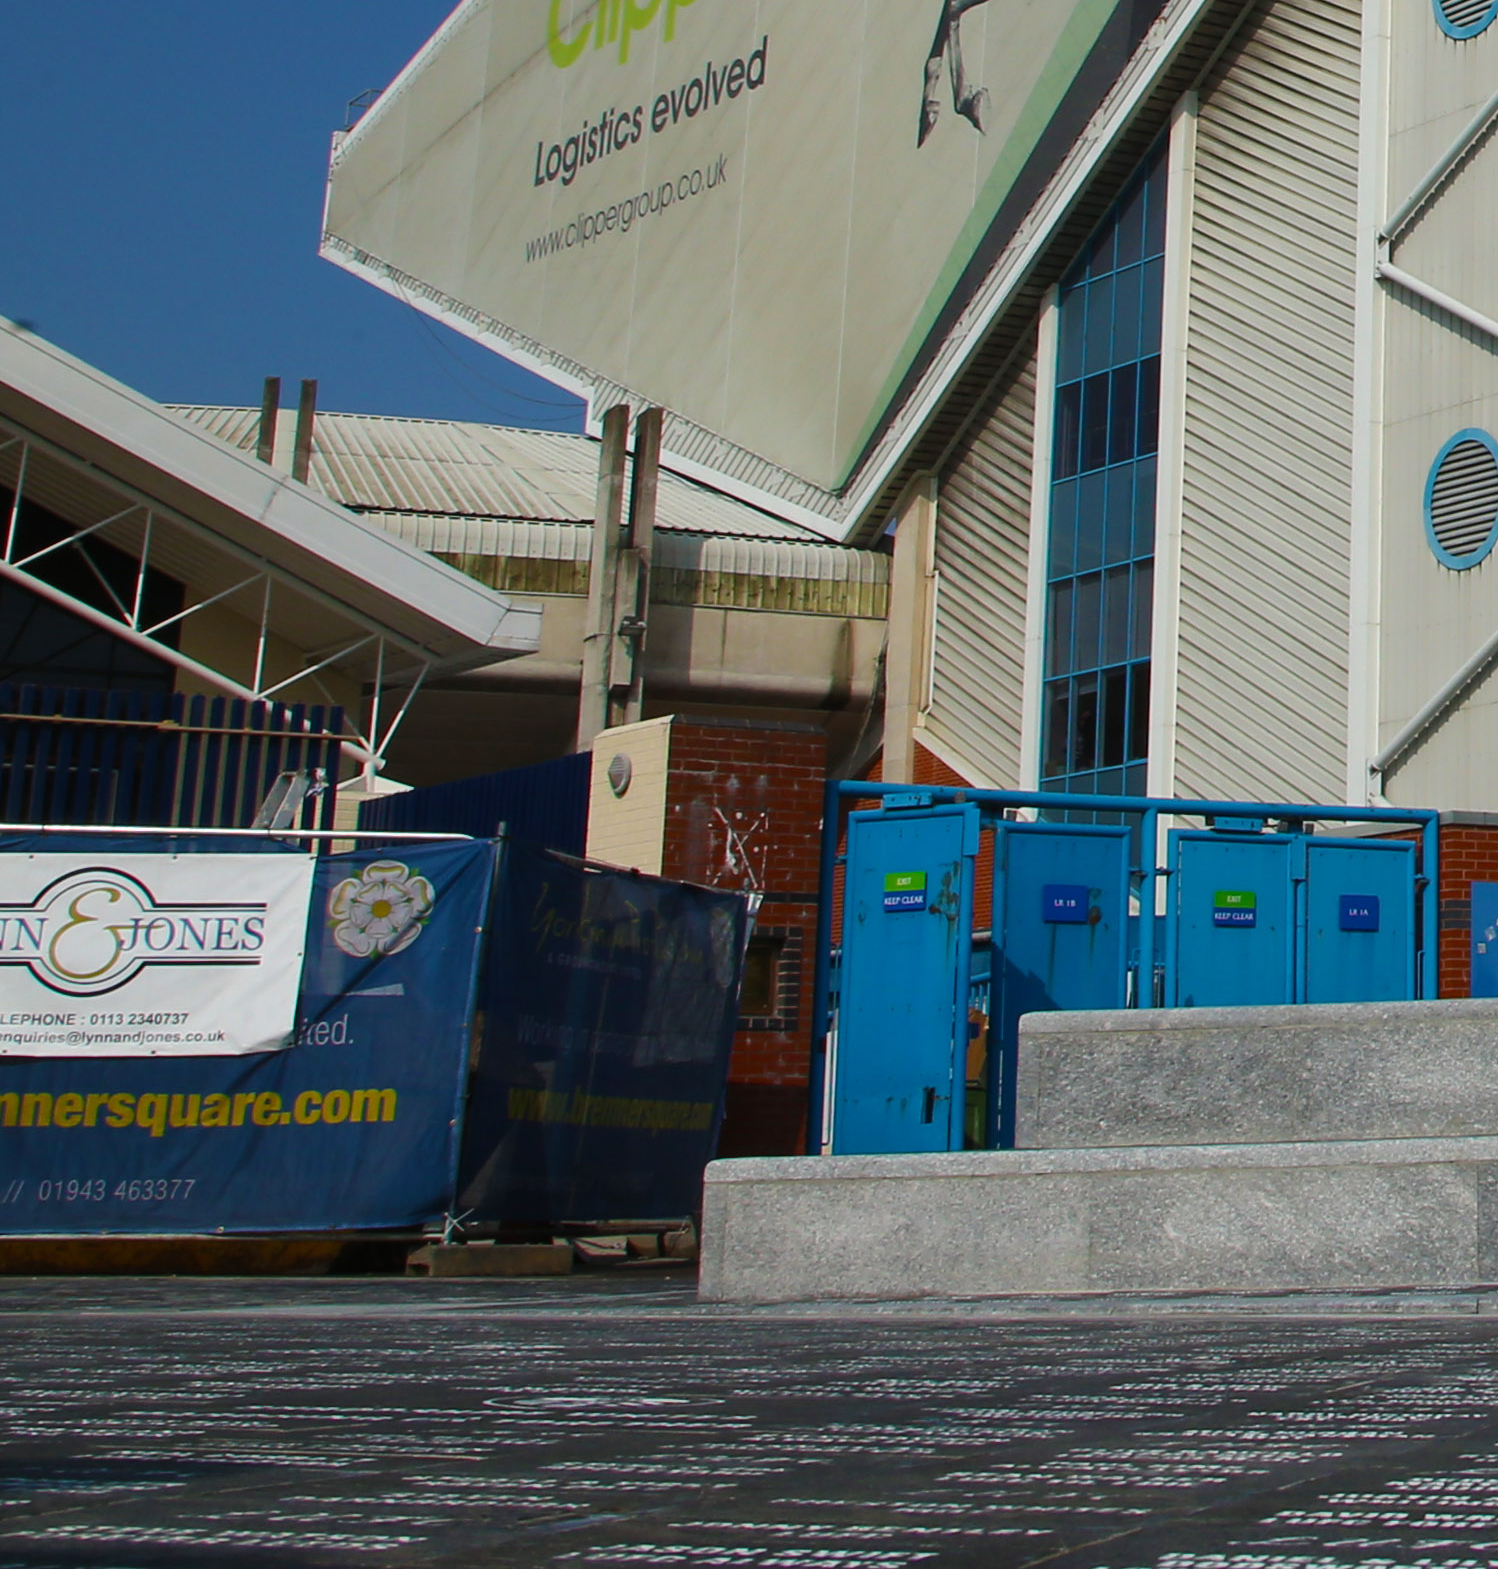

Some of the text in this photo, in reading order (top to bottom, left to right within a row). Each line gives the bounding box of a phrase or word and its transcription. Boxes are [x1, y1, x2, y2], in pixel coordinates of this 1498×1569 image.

[533, 35, 768, 187] Logistics evolved
[526, 153, 728, 264] www.clippergroup.co.uk
[896, 877, 912, 886] EXIT
[884, 895, 924, 905] KEEP CLEAR
[1227, 895, 1241, 903] EXIT
[1214, 912, 1254, 920] KEEP CLEAR
[118, 917, 265, 952] JONES
[90, 1013, 124, 1026] 0113
[128, 1013, 189, 1026] 2340737
[38, 1179, 107, 1202] 01943
[114, 1178, 197, 1201] 463377
[773, 1548, 941, 1562] SWIFT
